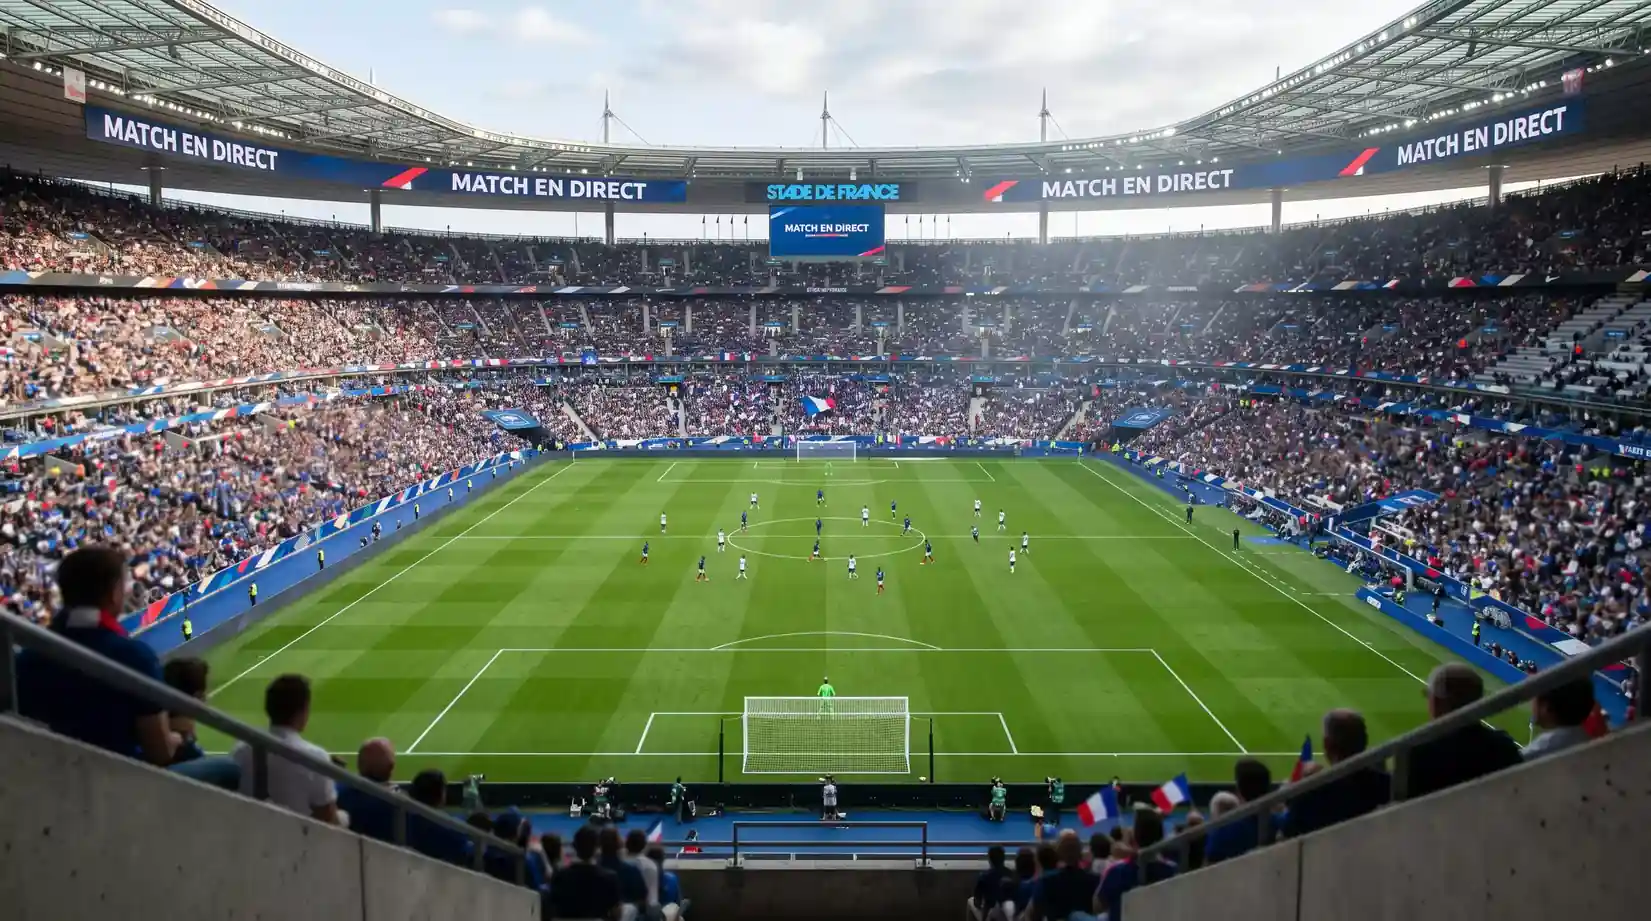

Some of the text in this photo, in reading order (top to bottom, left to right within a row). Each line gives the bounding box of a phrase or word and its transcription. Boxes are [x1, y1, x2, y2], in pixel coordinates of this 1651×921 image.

[104, 114, 279, 171] MATCH EN DIRECT
[1397, 105, 1567, 166] MATCH EN DIRECT
[451, 172, 647, 200] MATCH EN DIRECT
[767, 184, 899, 200] STADE DE FRANCE
[1041, 168, 1234, 199] MATCH EN DIRECT
[784, 223, 869, 233] MATCH EN DIRECT
